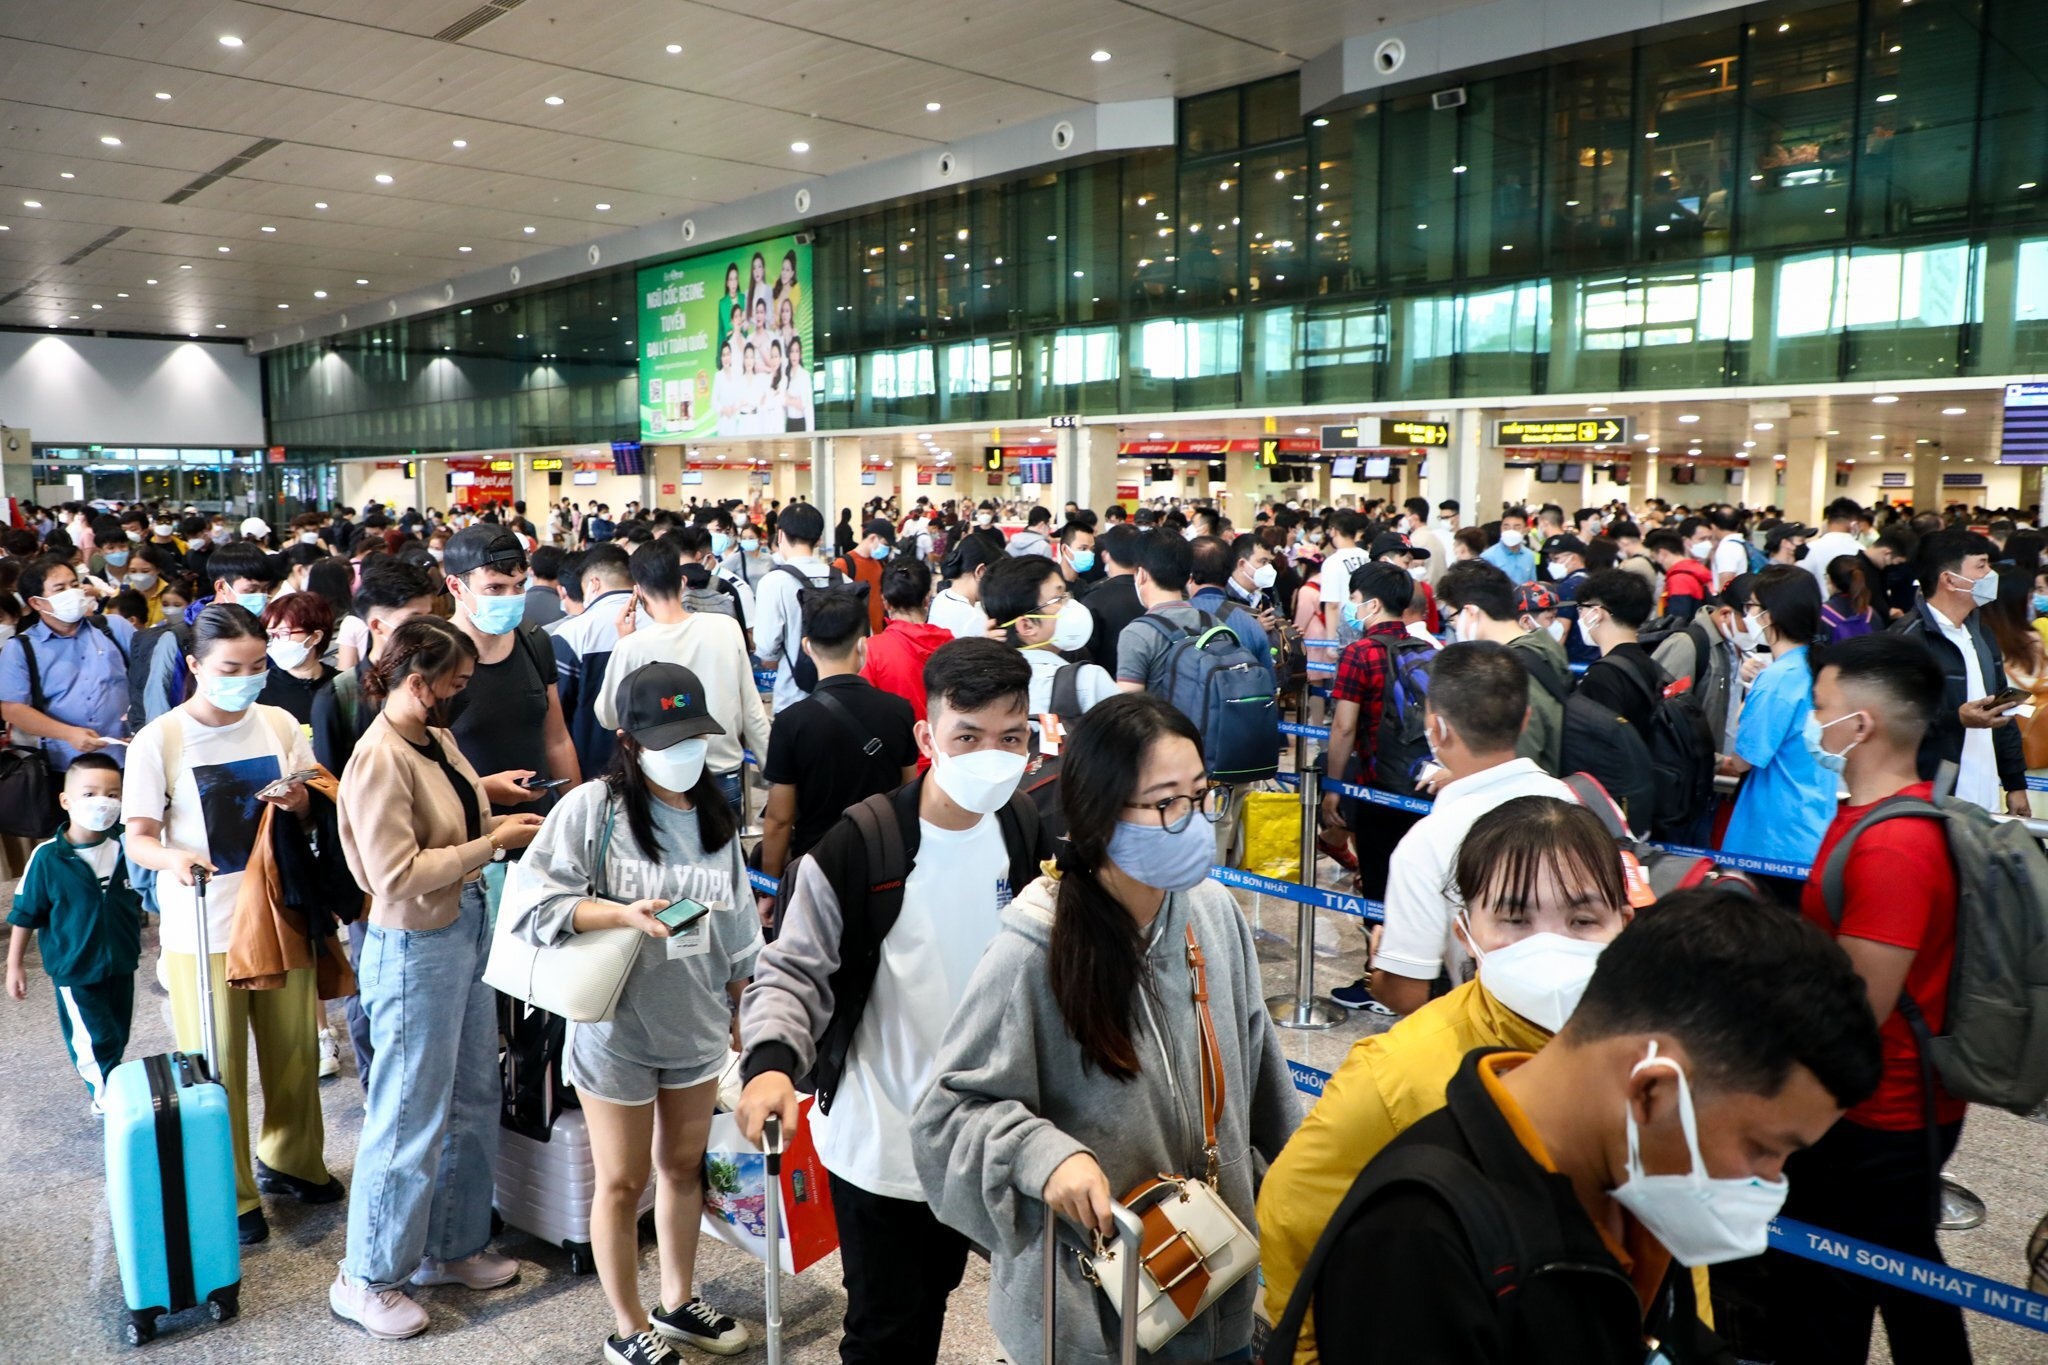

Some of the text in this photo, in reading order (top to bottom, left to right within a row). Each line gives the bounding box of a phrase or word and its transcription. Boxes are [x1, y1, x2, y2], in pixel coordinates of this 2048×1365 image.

[988, 448, 1001, 470] J
[1263, 441, 1278, 465] K
[1342, 783, 1371, 800] TIA
[1714, 854, 1735, 865] TAN
[1738, 858, 1761, 870] SON
[1764, 862, 1795, 875] NHAT
[606, 857, 736, 909] NEW YORK
[1223, 869, 1241, 883] TÂN
[1242, 874, 1262, 888] SƠN
[1322, 893, 1361, 914] TIA
[1291, 1069, 1326, 1090] KHÔN
[1806, 1233, 1850, 1260] TAN
[1855, 1249, 1905, 1277] SON
[1911, 1266, 1977, 1299] NHAT
